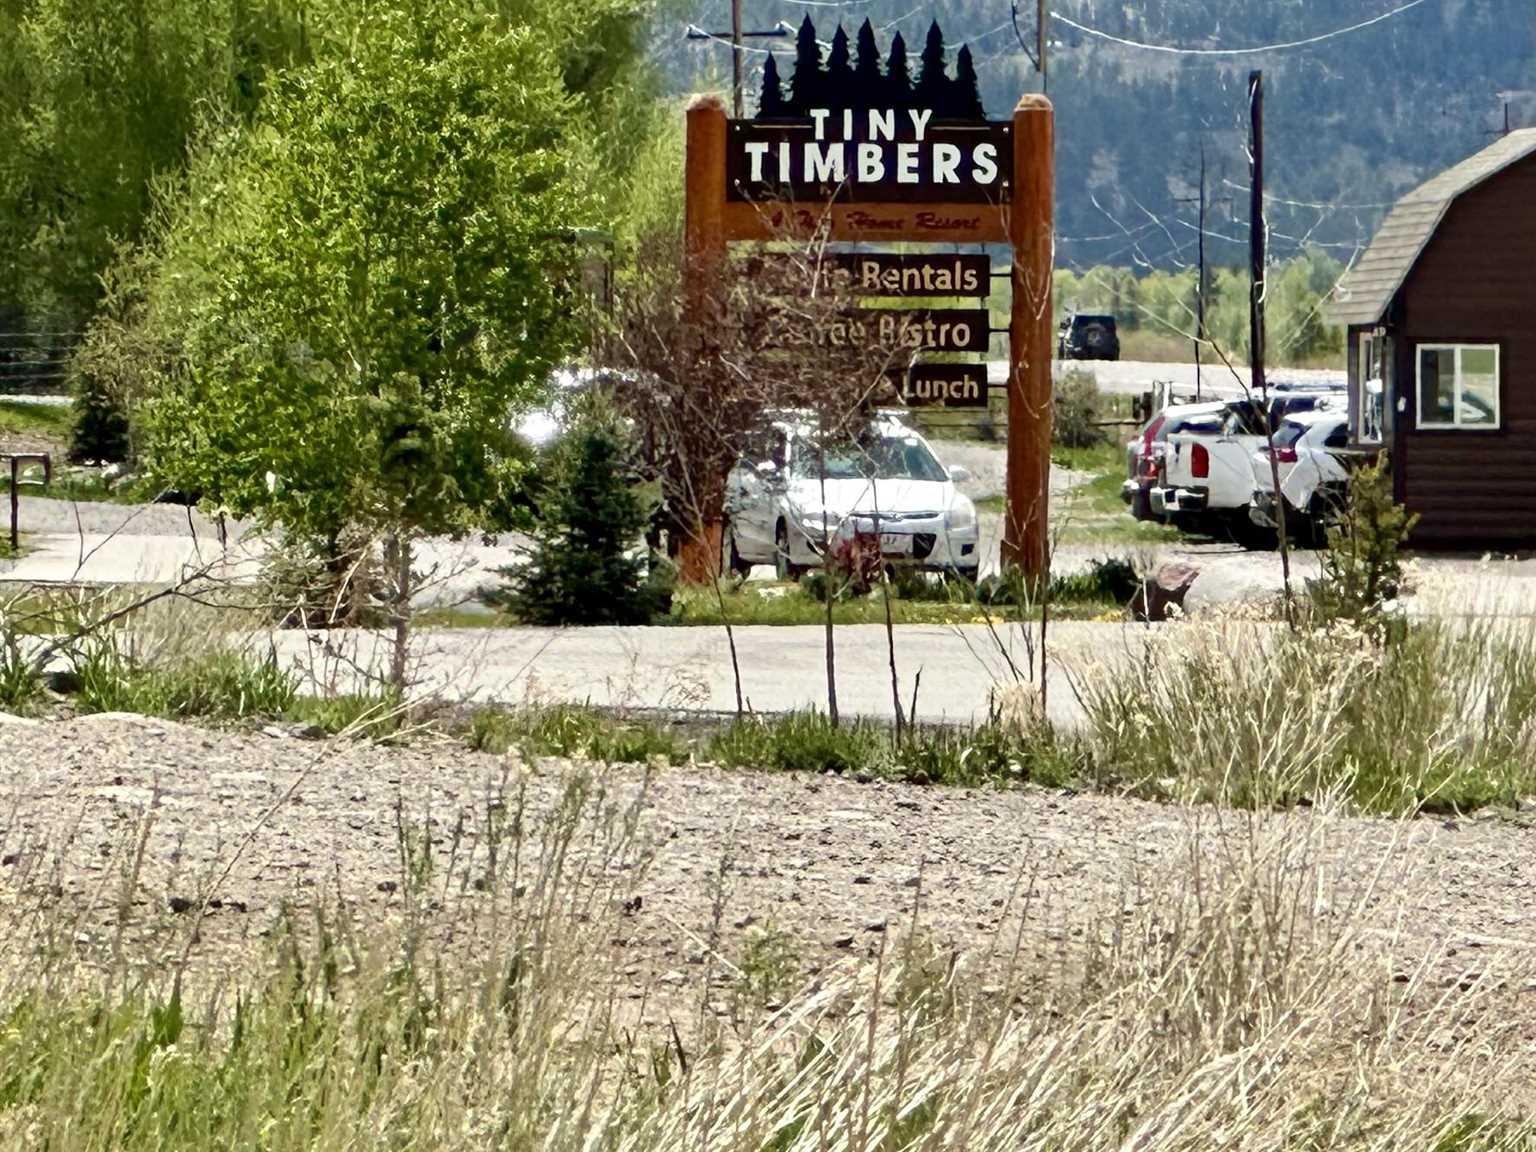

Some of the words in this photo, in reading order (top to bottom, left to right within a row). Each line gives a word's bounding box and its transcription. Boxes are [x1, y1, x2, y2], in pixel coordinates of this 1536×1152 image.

[810, 108, 933, 140] TINY
[745, 142, 999, 184] TIMBERS
[862, 261, 977, 291] Rentals
[903, 375, 978, 399] Lunch
